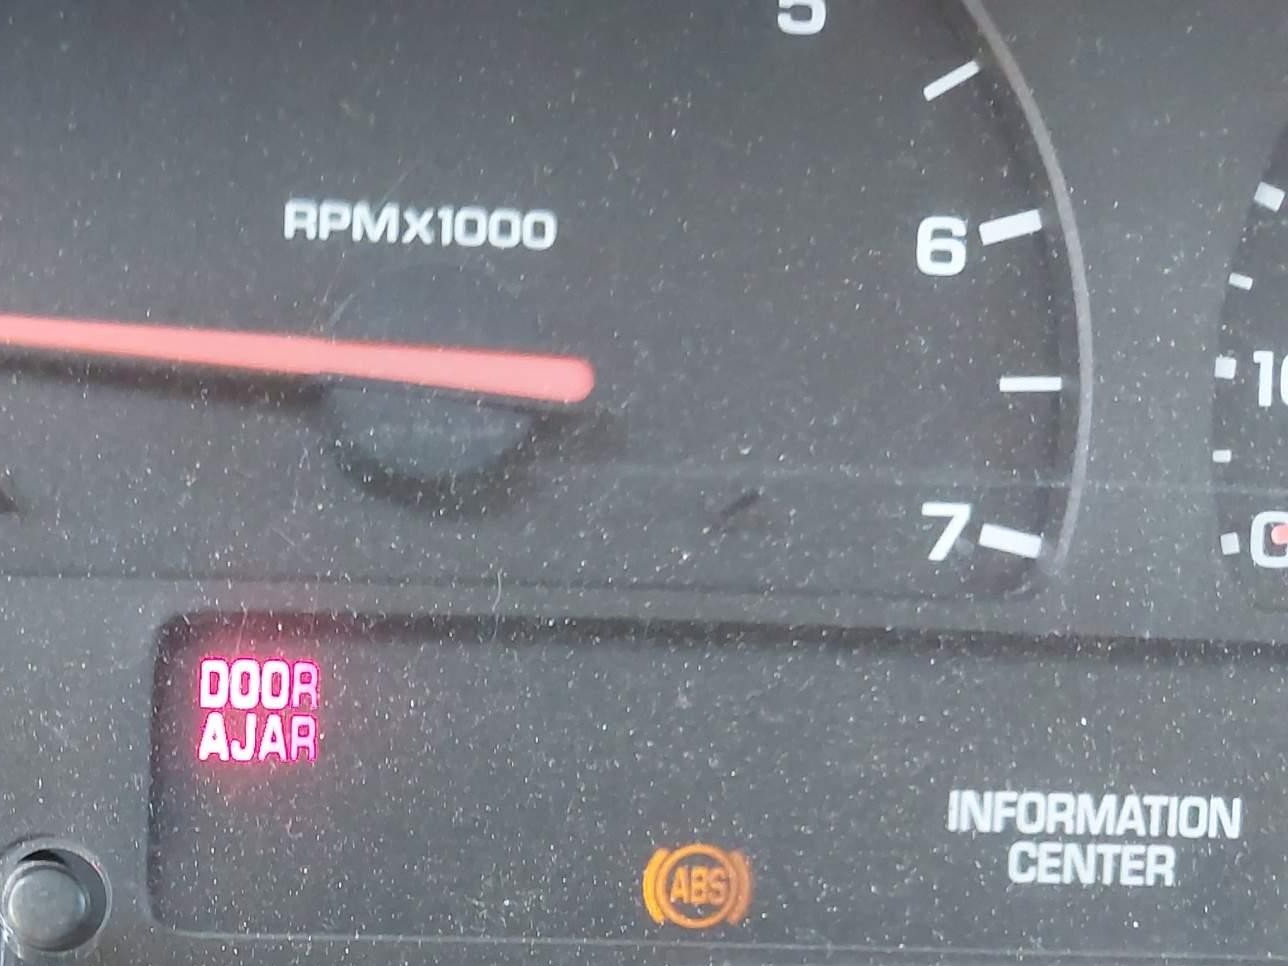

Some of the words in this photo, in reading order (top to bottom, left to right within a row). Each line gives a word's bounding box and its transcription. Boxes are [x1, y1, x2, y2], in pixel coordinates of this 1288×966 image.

[915, 214, 968, 276] 6
[1253, 350, 1288, 407] 1
[919, 501, 972, 562] 7
[199, 658, 319, 709] DOOR
[198, 711, 318, 762] AJAR
[948, 788, 1243, 840] INFORMATION
[670, 865, 730, 905] ABS
[1007, 840, 1178, 888] CENTER
